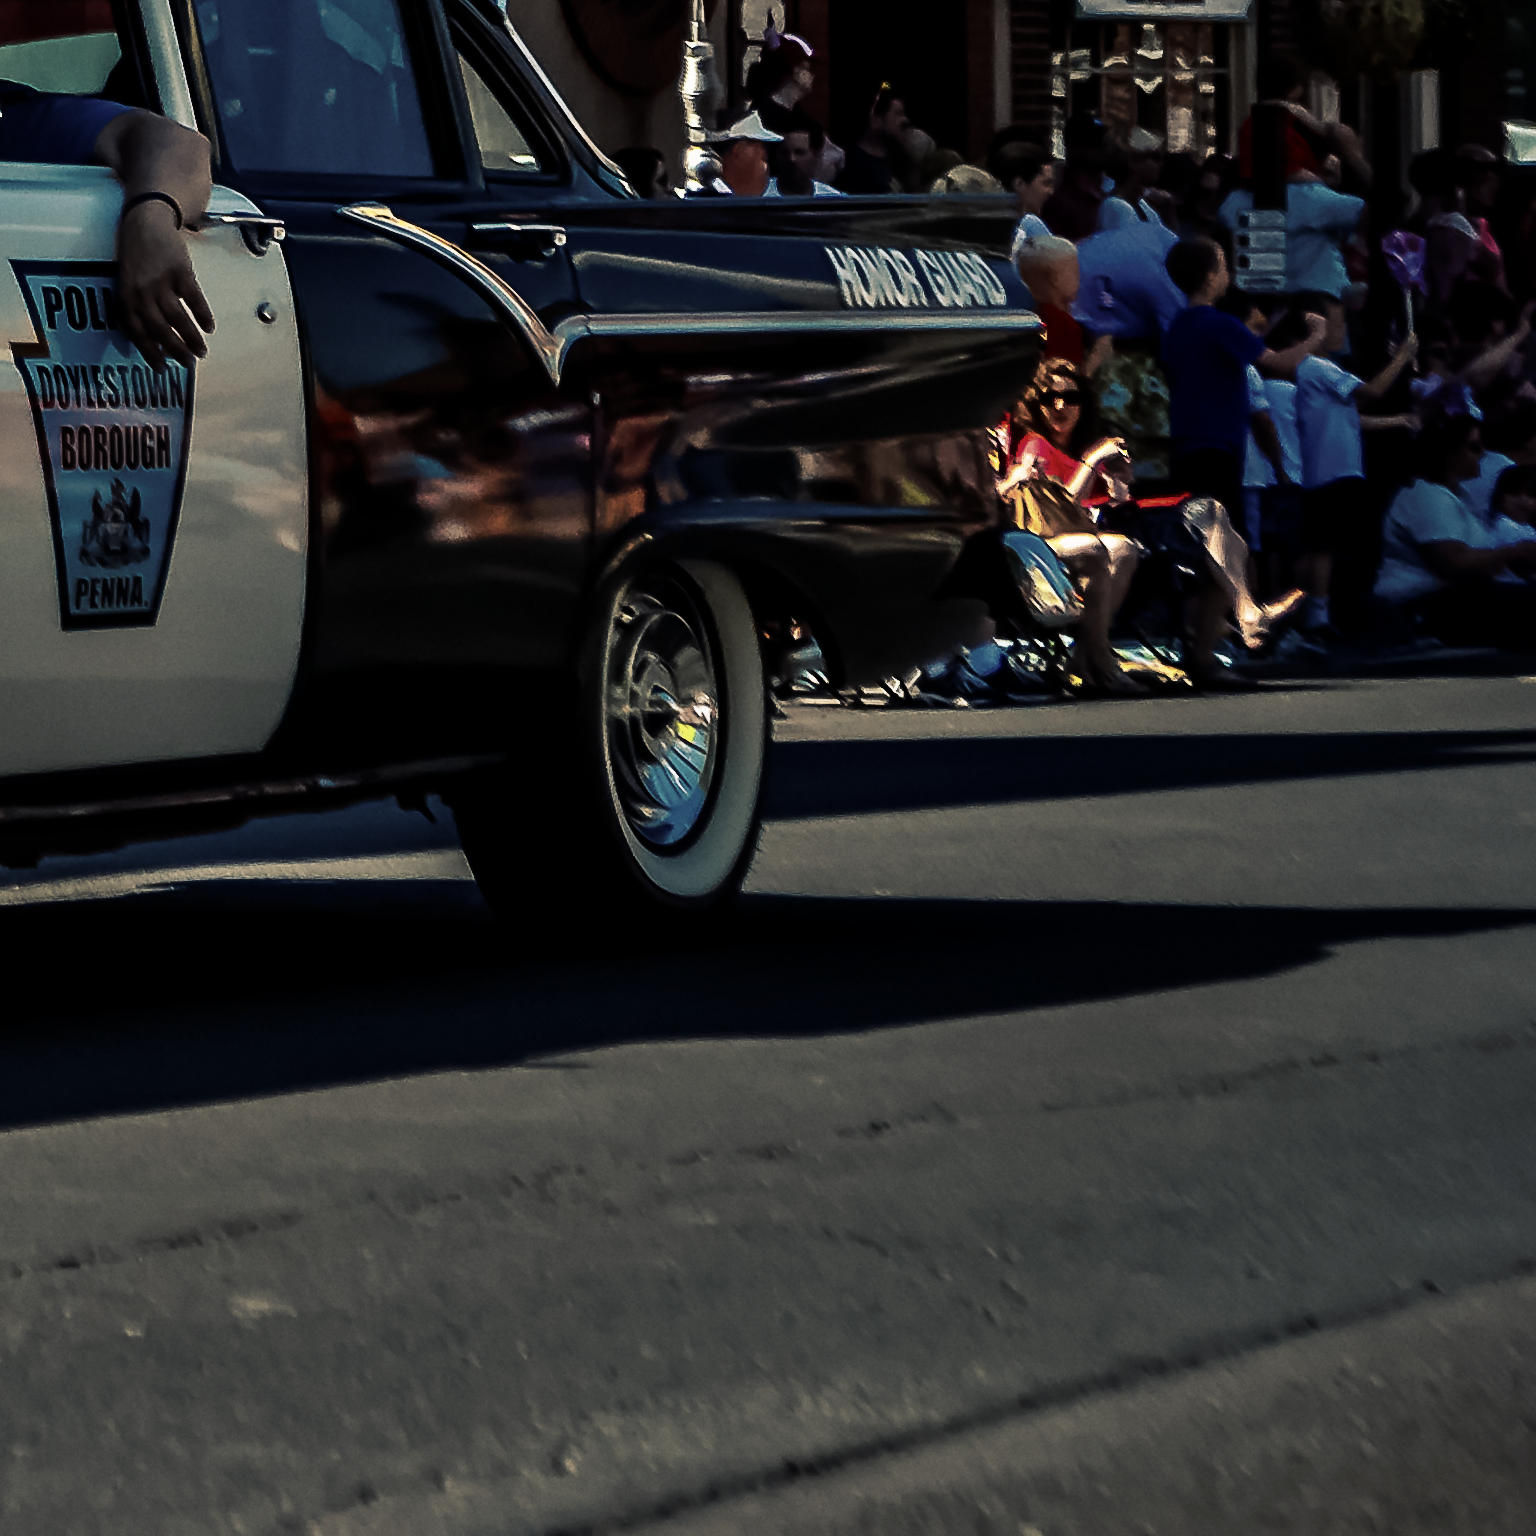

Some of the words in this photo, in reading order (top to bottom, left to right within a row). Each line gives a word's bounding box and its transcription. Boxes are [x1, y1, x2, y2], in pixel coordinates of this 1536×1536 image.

[824, 245, 928, 308] HONOR
[913, 248, 1007, 307] GUARD
[41, 286, 119, 331] POLI
[36, 364, 184, 410] DOYLESTOWN
[61, 425, 171, 471] BOROUGH
[74, 575, 150, 611] PENNA.
